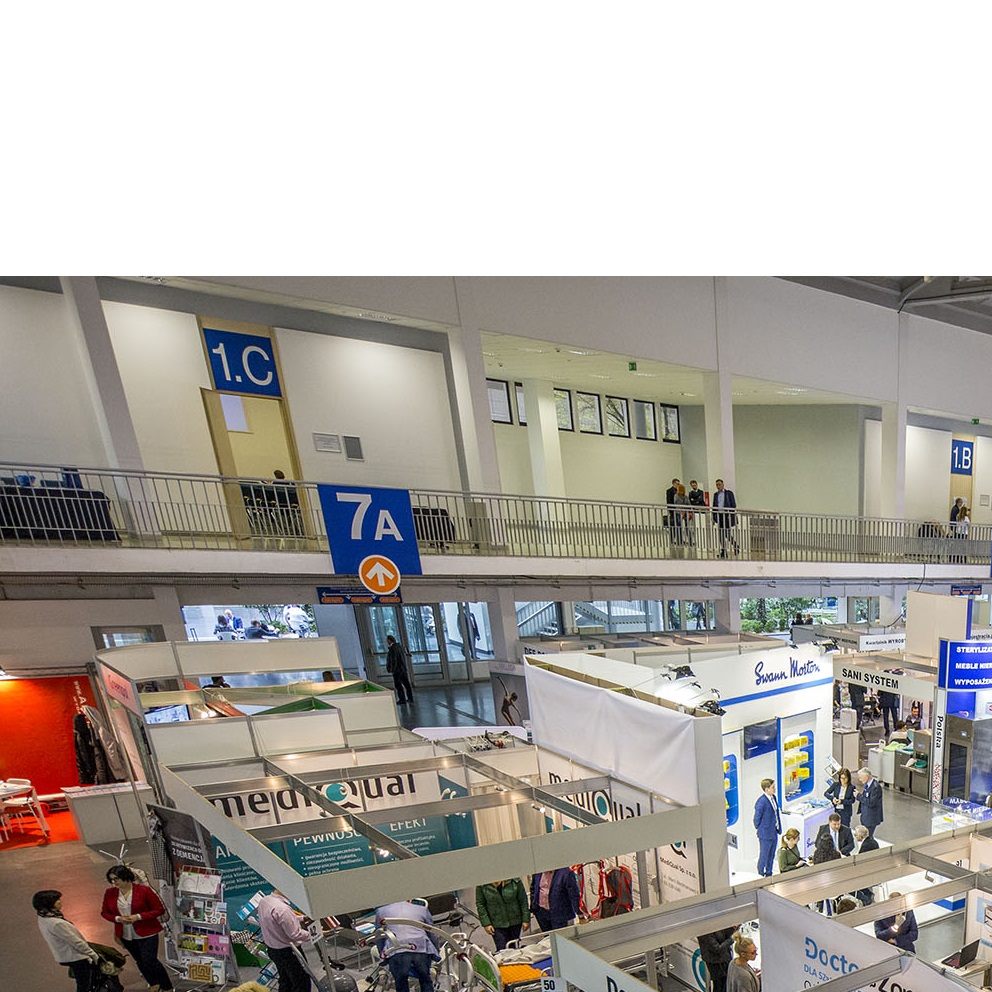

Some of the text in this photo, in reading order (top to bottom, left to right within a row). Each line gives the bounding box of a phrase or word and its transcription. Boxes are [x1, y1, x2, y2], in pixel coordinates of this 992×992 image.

[212, 342, 273, 386] 1.C
[953, 446, 971, 469] 1.B
[336, 492, 404, 541] 7A
[755, 657, 821, 686] Swann Morton
[842, 668, 899, 689] SANI SYSTEM
[935, 715, 943, 748] Polska
[804, 964, 818, 978] DLA
[543, 980, 556, 991] 50
